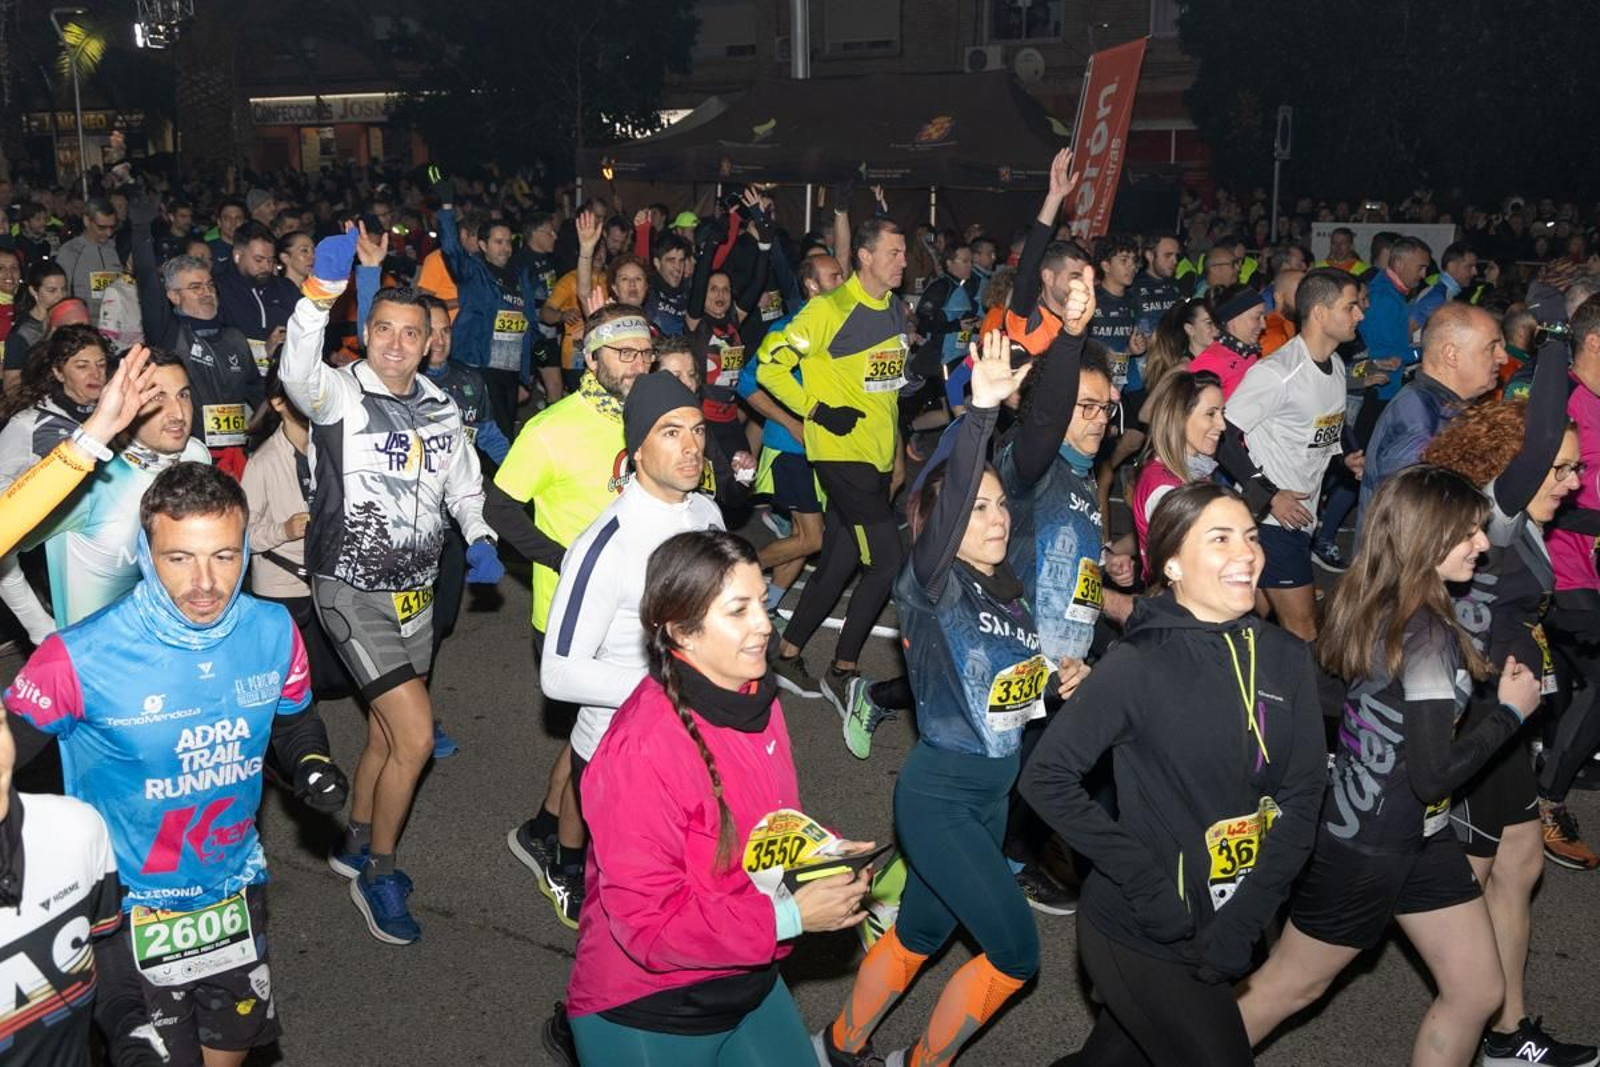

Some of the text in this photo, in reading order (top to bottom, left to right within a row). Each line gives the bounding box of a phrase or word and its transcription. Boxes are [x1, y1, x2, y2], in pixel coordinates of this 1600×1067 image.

[498, 319, 527, 330] 3217
[174, 717, 251, 753] ADRA
[178, 741, 245, 774] TRAIL
[145, 757, 262, 799] RUNNING
[747, 836, 808, 873] 3550
[144, 903, 243, 959] 2606
